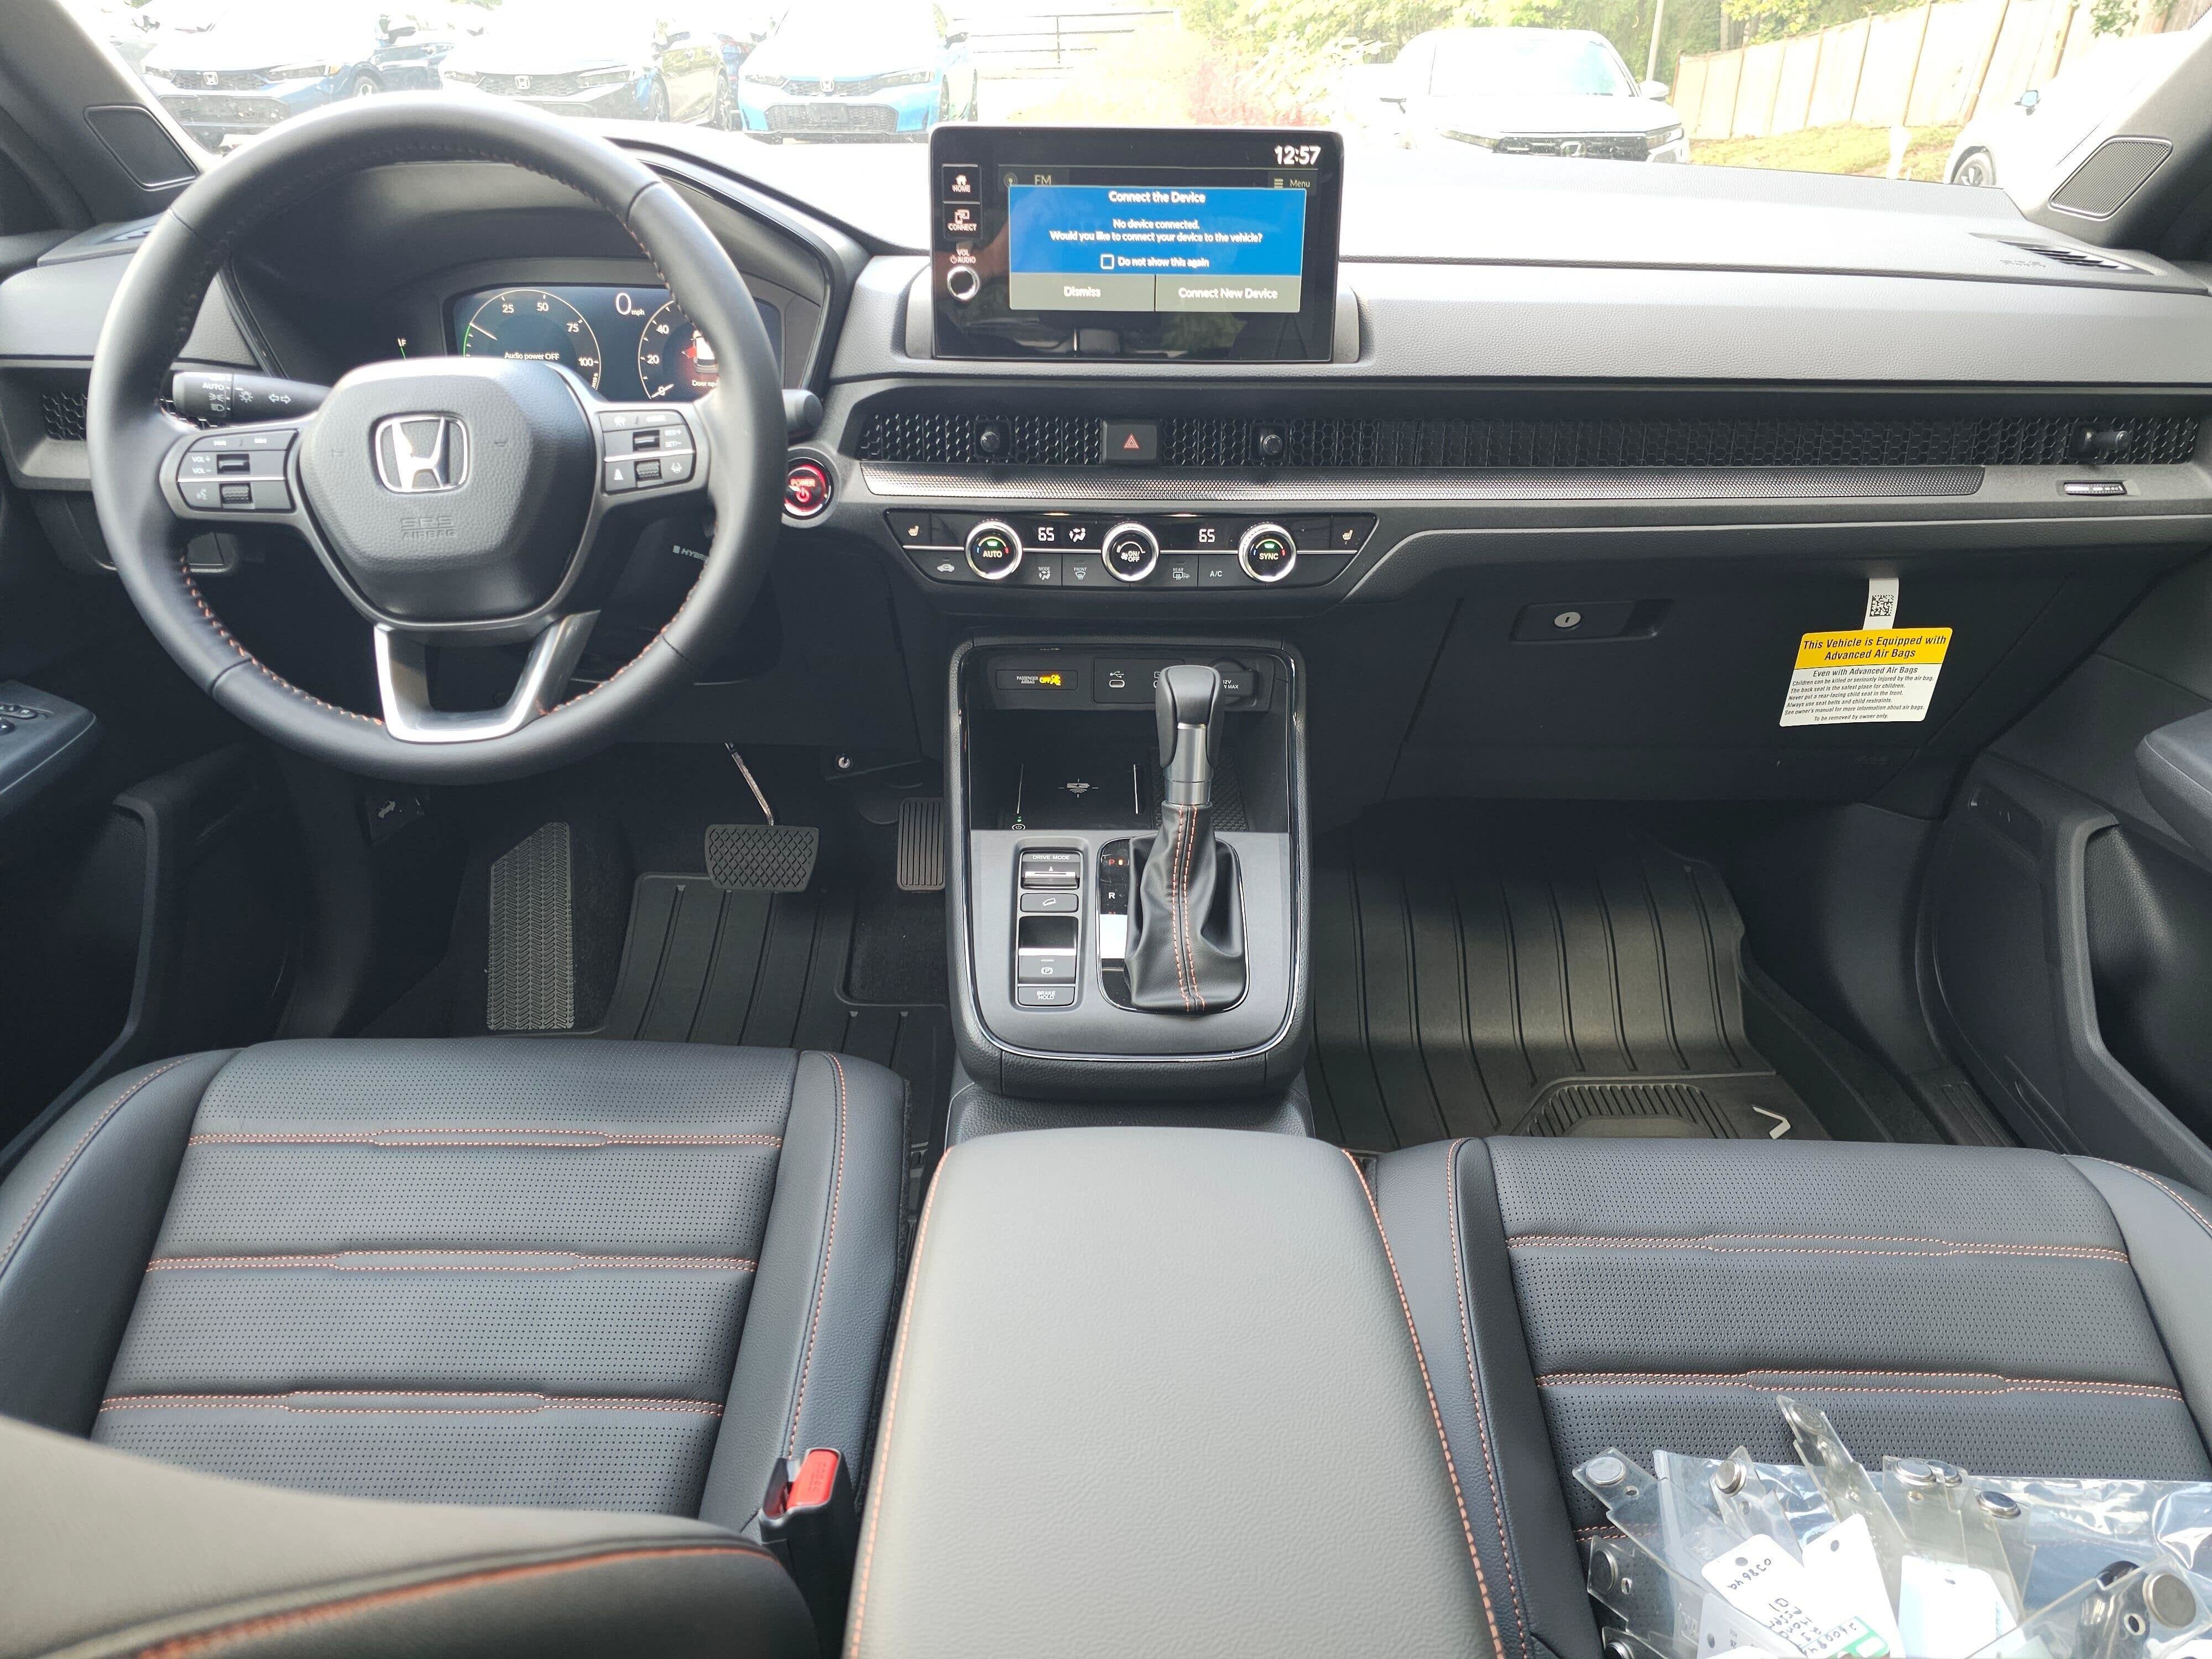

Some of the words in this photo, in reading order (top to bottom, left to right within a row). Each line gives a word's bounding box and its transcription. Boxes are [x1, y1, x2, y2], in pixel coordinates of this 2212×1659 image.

[1274, 145, 1321, 164] 12:57
[1034, 174, 1051, 185] FM
[1290, 179, 1310, 187] Menu
[1109, 191, 1151, 203] Connect
[1152, 191, 1168, 203] the
[1171, 191, 1206, 203] Device
[948, 223, 977, 231] CONNECT
[1113, 218, 1126, 228] No
[1127, 220, 1154, 229] device
[1155, 220, 1200, 229] connected.
[1049, 231, 1078, 241] Would
[1079, 232, 1094, 242] you
[1096, 231, 1110, 241] like
[1112, 232, 1121, 241] to
[1123, 233, 1155, 241] connect
[1156, 233, 1176, 243] your
[1176, 232, 1203, 242] device
[1204, 232, 1214, 242] to
[1215, 232, 1229, 242] the
[1230, 233, 1262, 243] vehicle?
[1118, 256, 1129, 266] Do
[1131, 257, 1146, 266] not
[1147, 257, 1170, 267] show
[1171, 257, 1186, 267] this
[1187, 258, 1209, 268] again
[1064, 286, 1102, 298] Dismiss
[1178, 288, 1218, 299] Connect
[1220, 288, 1243, 299] New
[1245, 288, 1278, 299] Device
[502, 304, 514, 313] 25
[536, 302, 549, 311] 50
[615, 293, 632, 315] 0
[567, 324, 579, 332] 75
[656, 325, 669, 335] 40
[578, 358, 594, 367] 100
[647, 355, 659, 364] 20
[791, 478, 816, 487] POWER
[401, 517, 452, 528] SRS
[403, 530, 456, 541] AIRBAG
[1038, 527, 1054, 541] 65
[1199, 529, 1215, 542] 65
[681, 548, 708, 561] HYBR
[983, 550, 1003, 558] AUTO
[1804, 640, 1823, 649] This
[1827, 638, 1861, 648] Vehicle
[1865, 637, 1873, 646] is
[1876, 636, 1922, 646] Equipped
[1926, 636, 1946, 644] with
[1825, 650, 1872, 660] Advanced
[1874, 649, 1888, 658] Air
[1892, 649, 1916, 659] Bags
